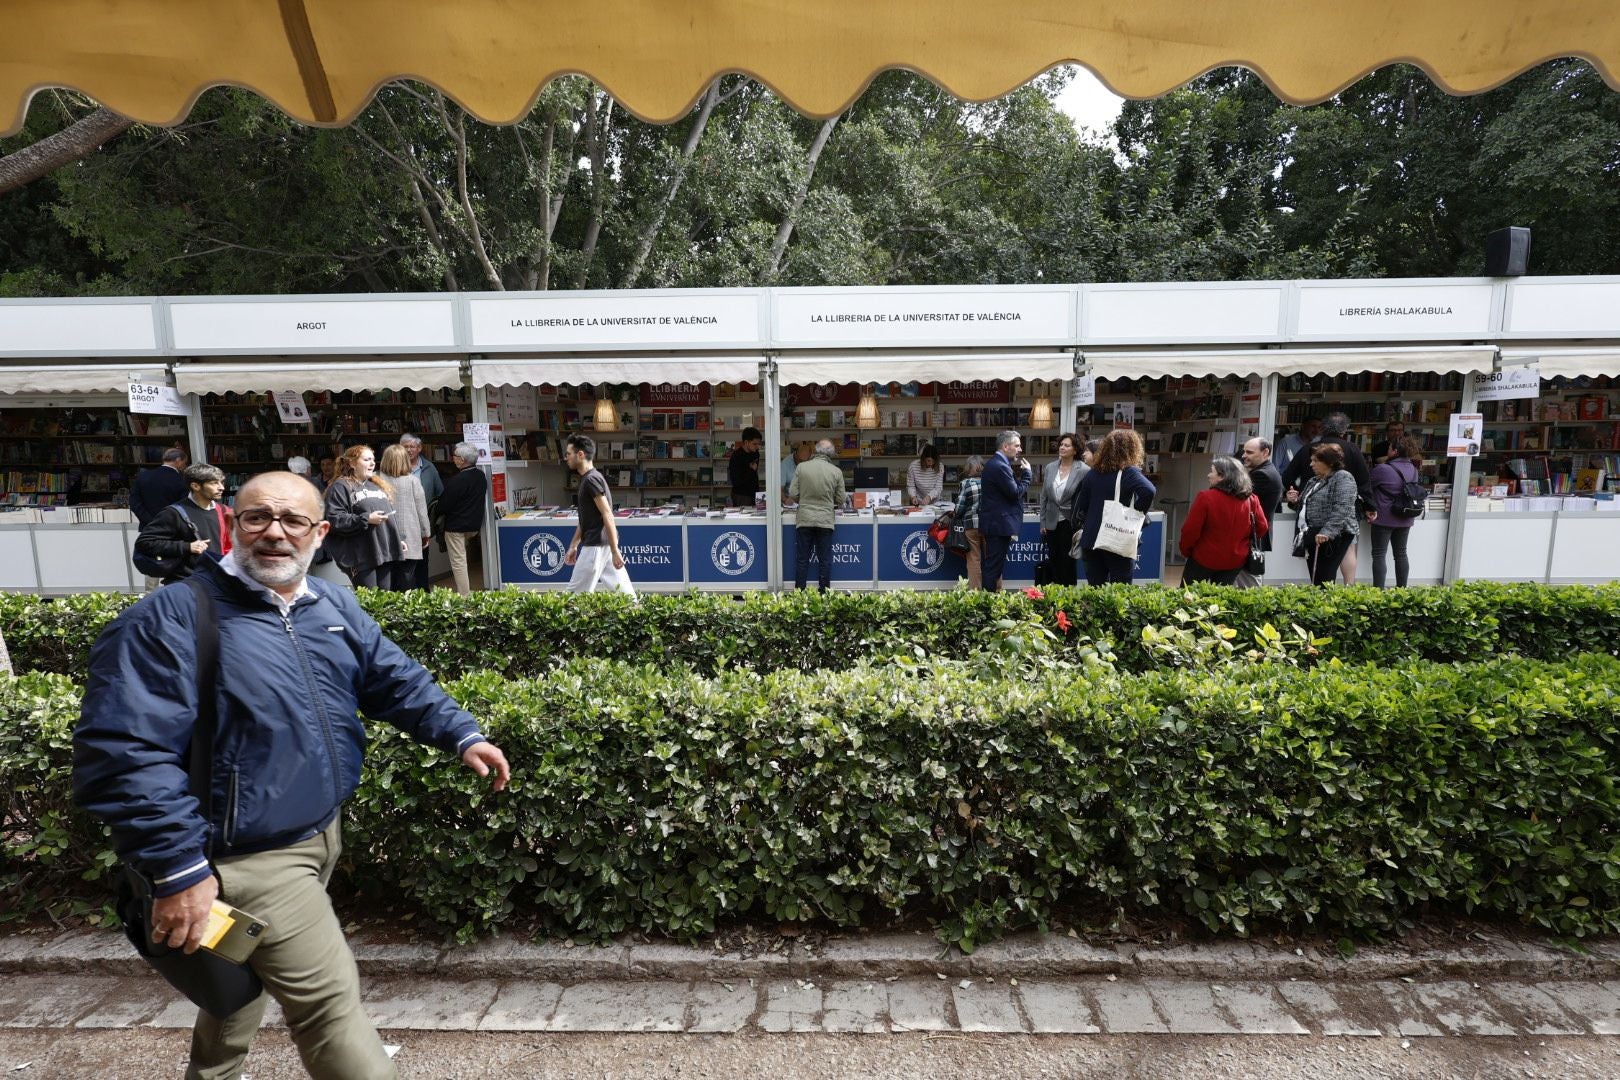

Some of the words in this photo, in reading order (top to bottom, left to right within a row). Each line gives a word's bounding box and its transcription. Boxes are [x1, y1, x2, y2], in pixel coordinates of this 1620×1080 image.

[1339, 305, 1382, 316] LIBRERÍA
[1384, 305, 1453, 316] SHALAKABULA
[511, 318, 523, 327] LA
[525, 318, 571, 327] LLIBRERIA
[572, 317, 585, 326] DE
[586, 317, 599, 326] LA
[600, 316, 657, 326] UNIVERSITAT
[659, 316, 671, 325] DE
[811, 313, 823, 323] LA
[825, 313, 872, 323] LLIBRERIA
[874, 313, 887, 322] DE
[888, 313, 901, 322] LA
[902, 312, 961, 322] UNIVERSITAT
[962, 312, 975, 321] DE
[296, 321, 327, 330] ARGOT
[130, 384, 159, 396] 63-64
[131, 394, 155, 402] ARGOT
